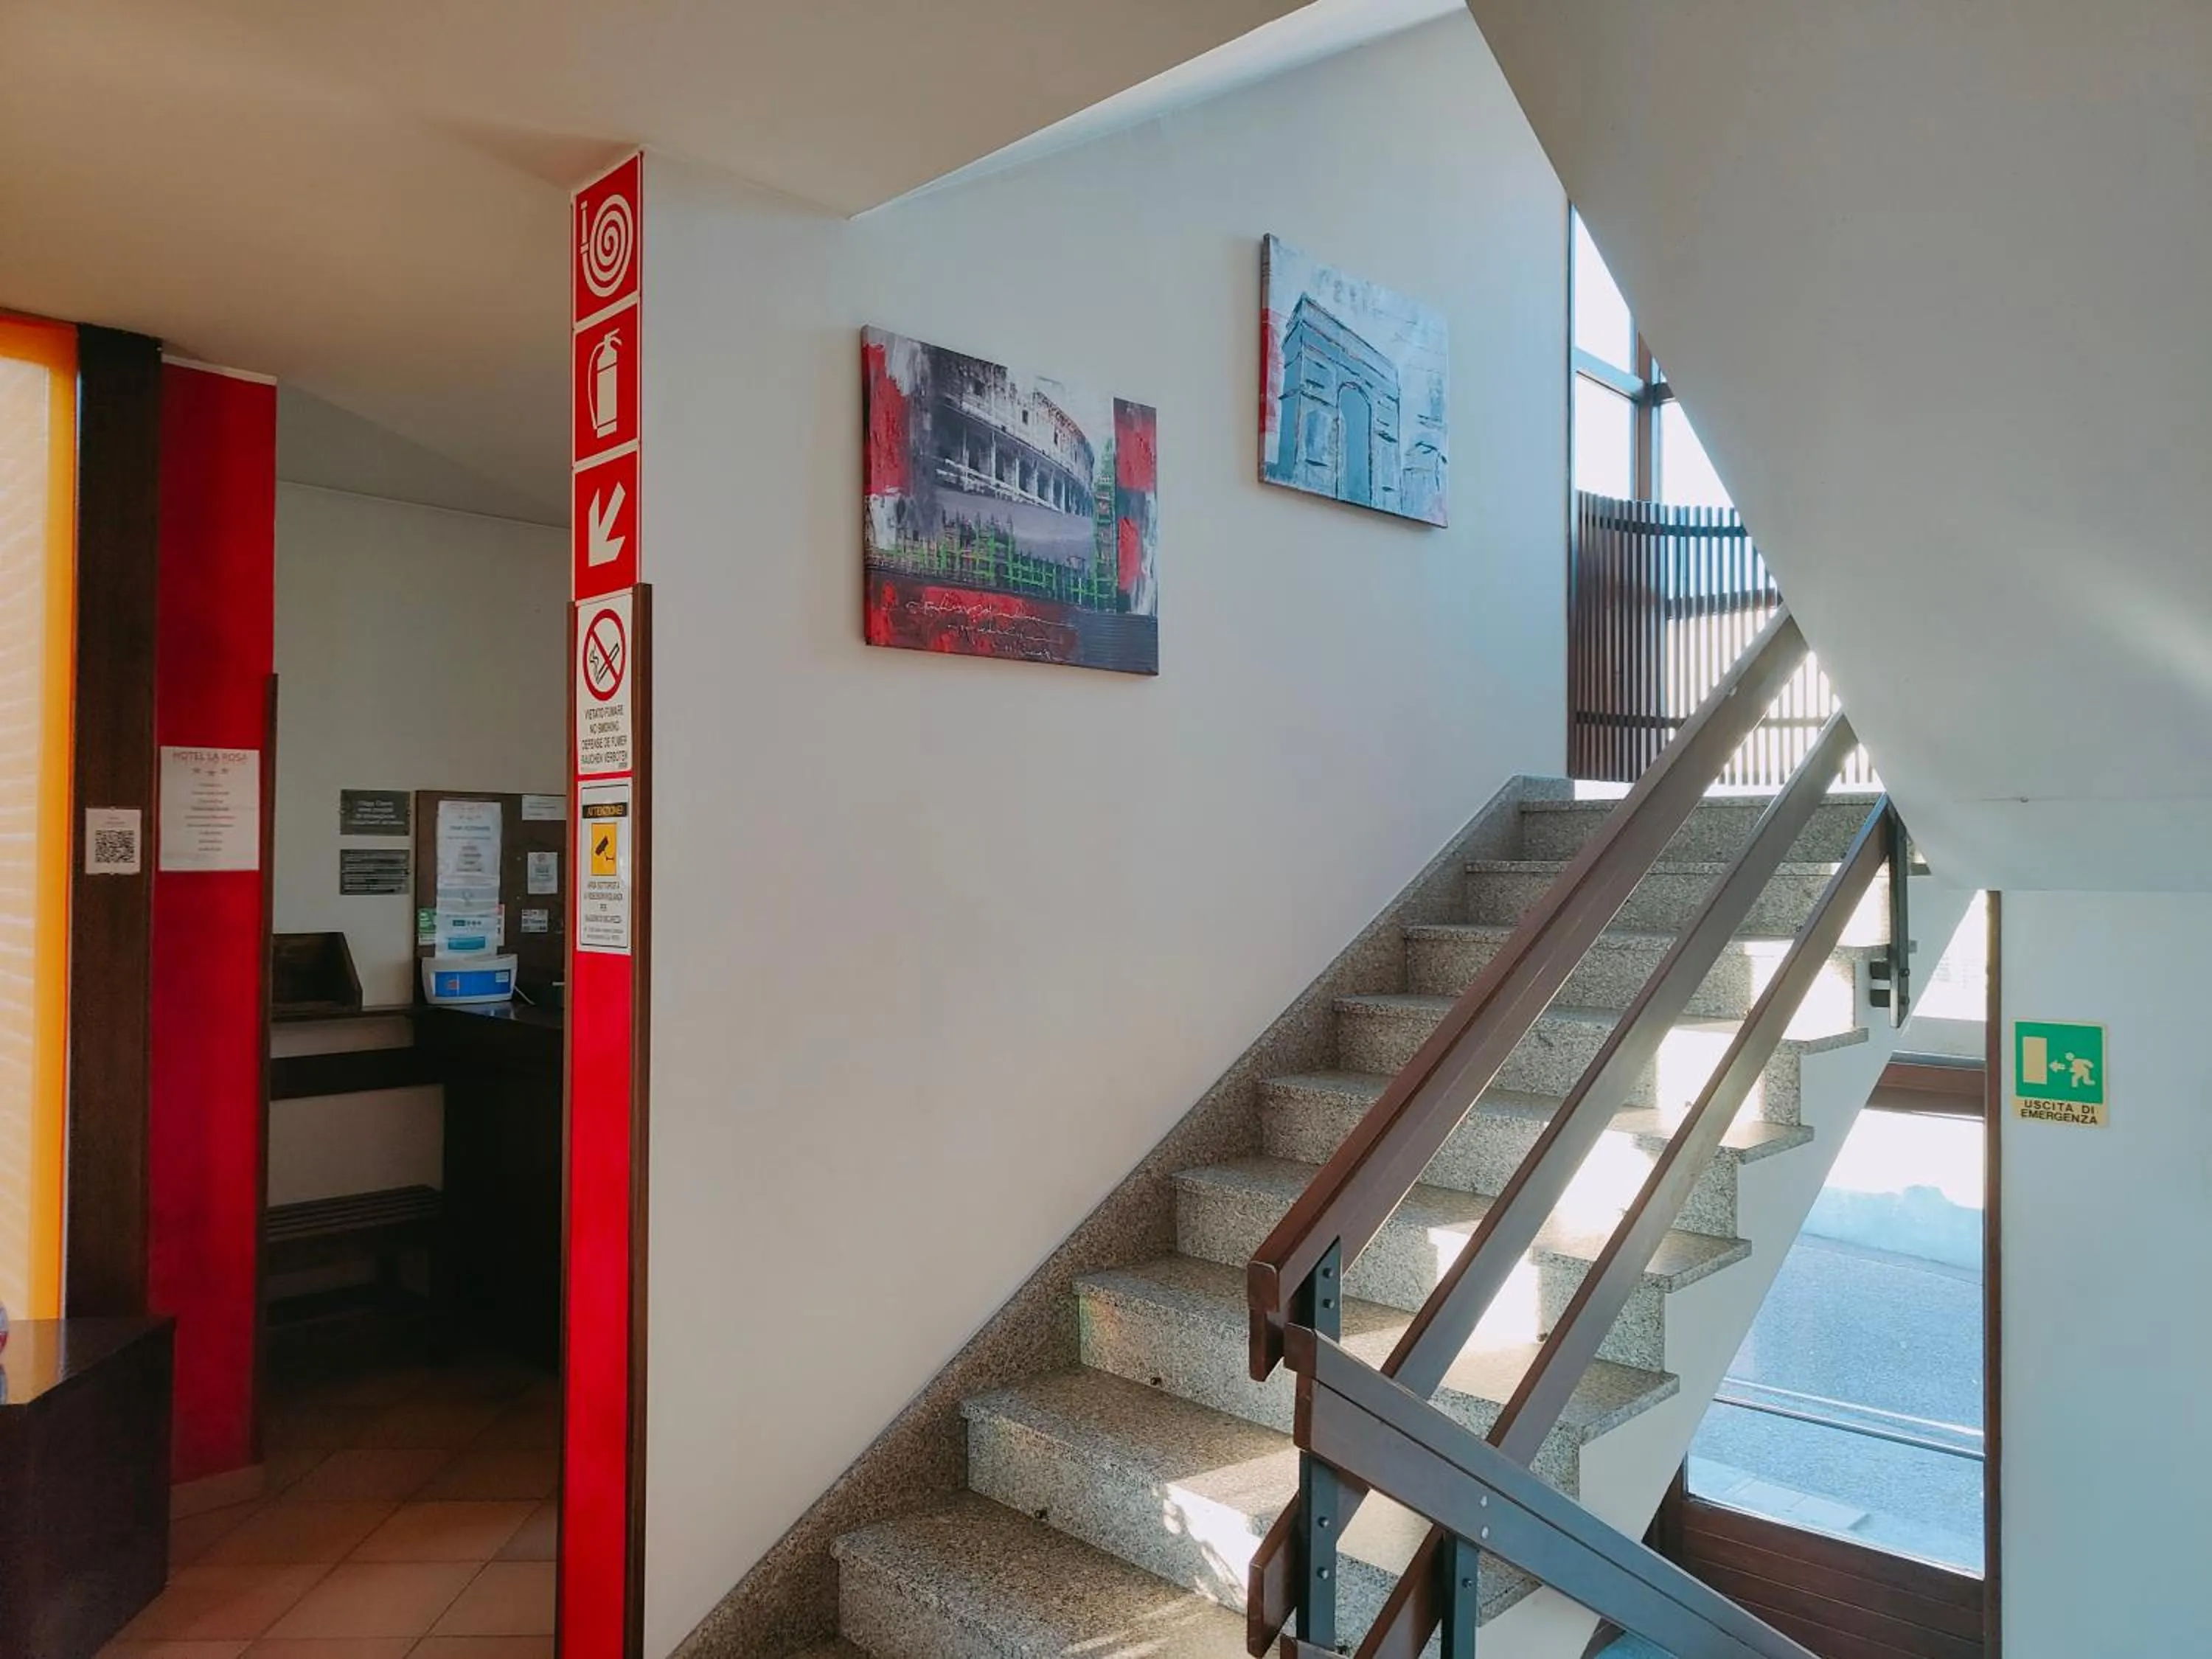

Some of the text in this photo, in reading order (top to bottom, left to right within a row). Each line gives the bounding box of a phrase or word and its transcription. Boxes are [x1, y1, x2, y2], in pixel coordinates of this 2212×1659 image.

[173, 751, 248, 763] HOTEL LA ROSA
[2024, 1099, 2095, 1114] USCITA DI
[2020, 1108, 2098, 1124] EMERGENZA
